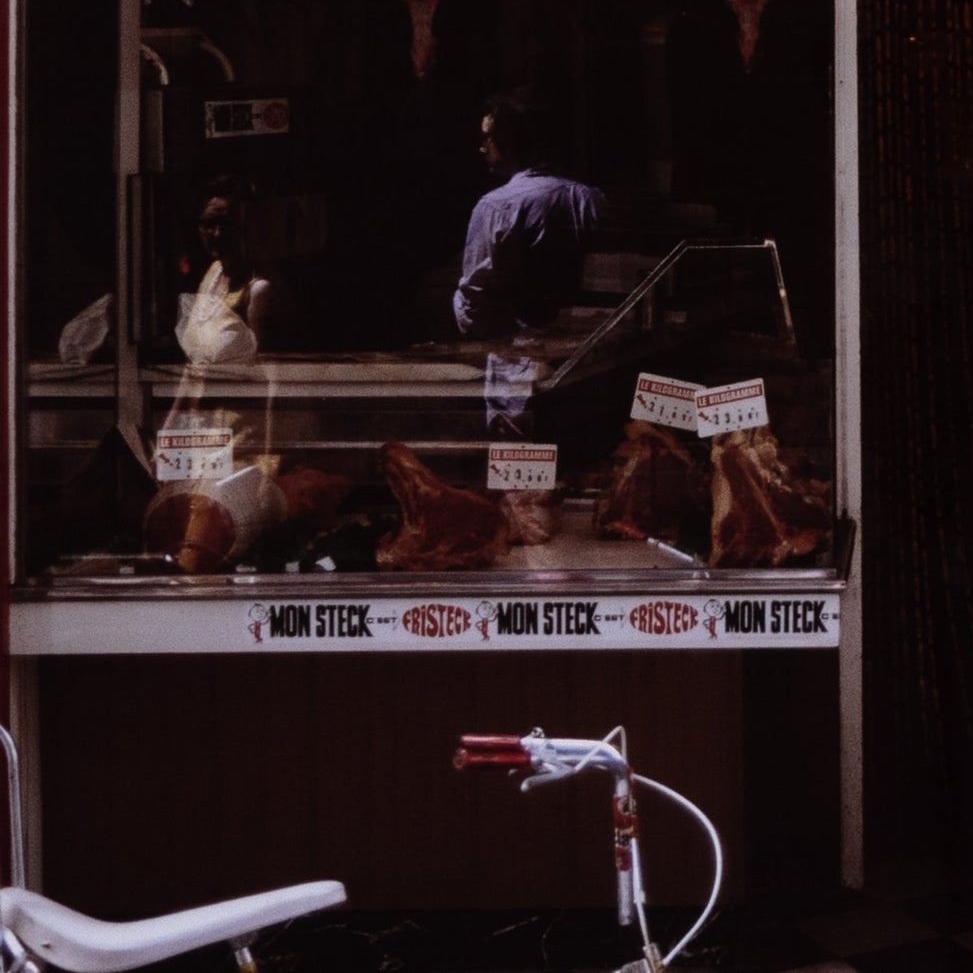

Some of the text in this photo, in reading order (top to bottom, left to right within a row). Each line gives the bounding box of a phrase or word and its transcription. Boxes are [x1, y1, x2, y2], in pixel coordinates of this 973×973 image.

[640, 380, 649, 391] LE
[698, 386, 761, 407] LE KILOGRAMME
[160, 437, 170, 447] LE
[492, 451, 553, 460] LE KILOGRAMME
[269, 604, 311, 638] MON
[315, 604, 373, 638] STECK
[496, 601, 538, 635] MON
[543, 601, 601, 635] STECK
[724, 600, 766, 634] MON
[770, 600, 828, 634] STECK
